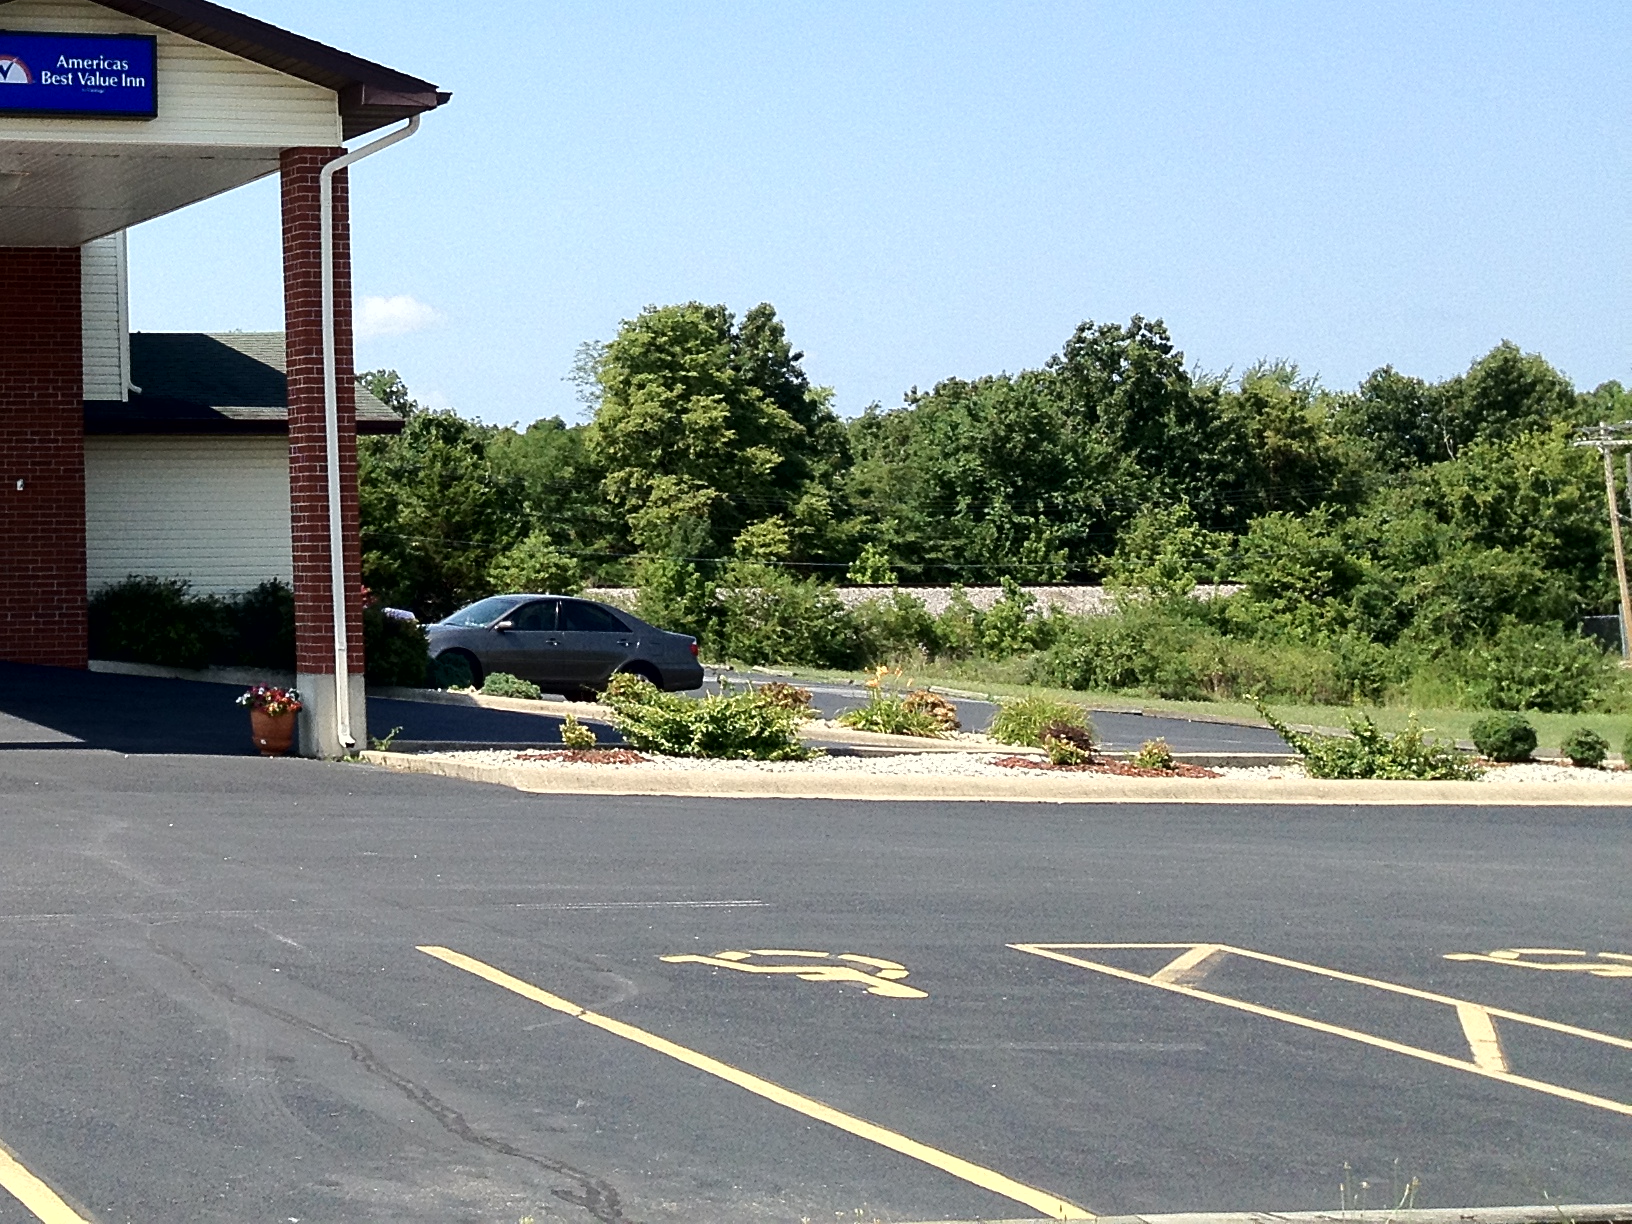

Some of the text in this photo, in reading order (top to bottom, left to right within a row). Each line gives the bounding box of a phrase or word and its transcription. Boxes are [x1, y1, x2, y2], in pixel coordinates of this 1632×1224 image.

[56, 55, 129, 70] Americas
[41, 71, 145, 87] Best Value Inn
